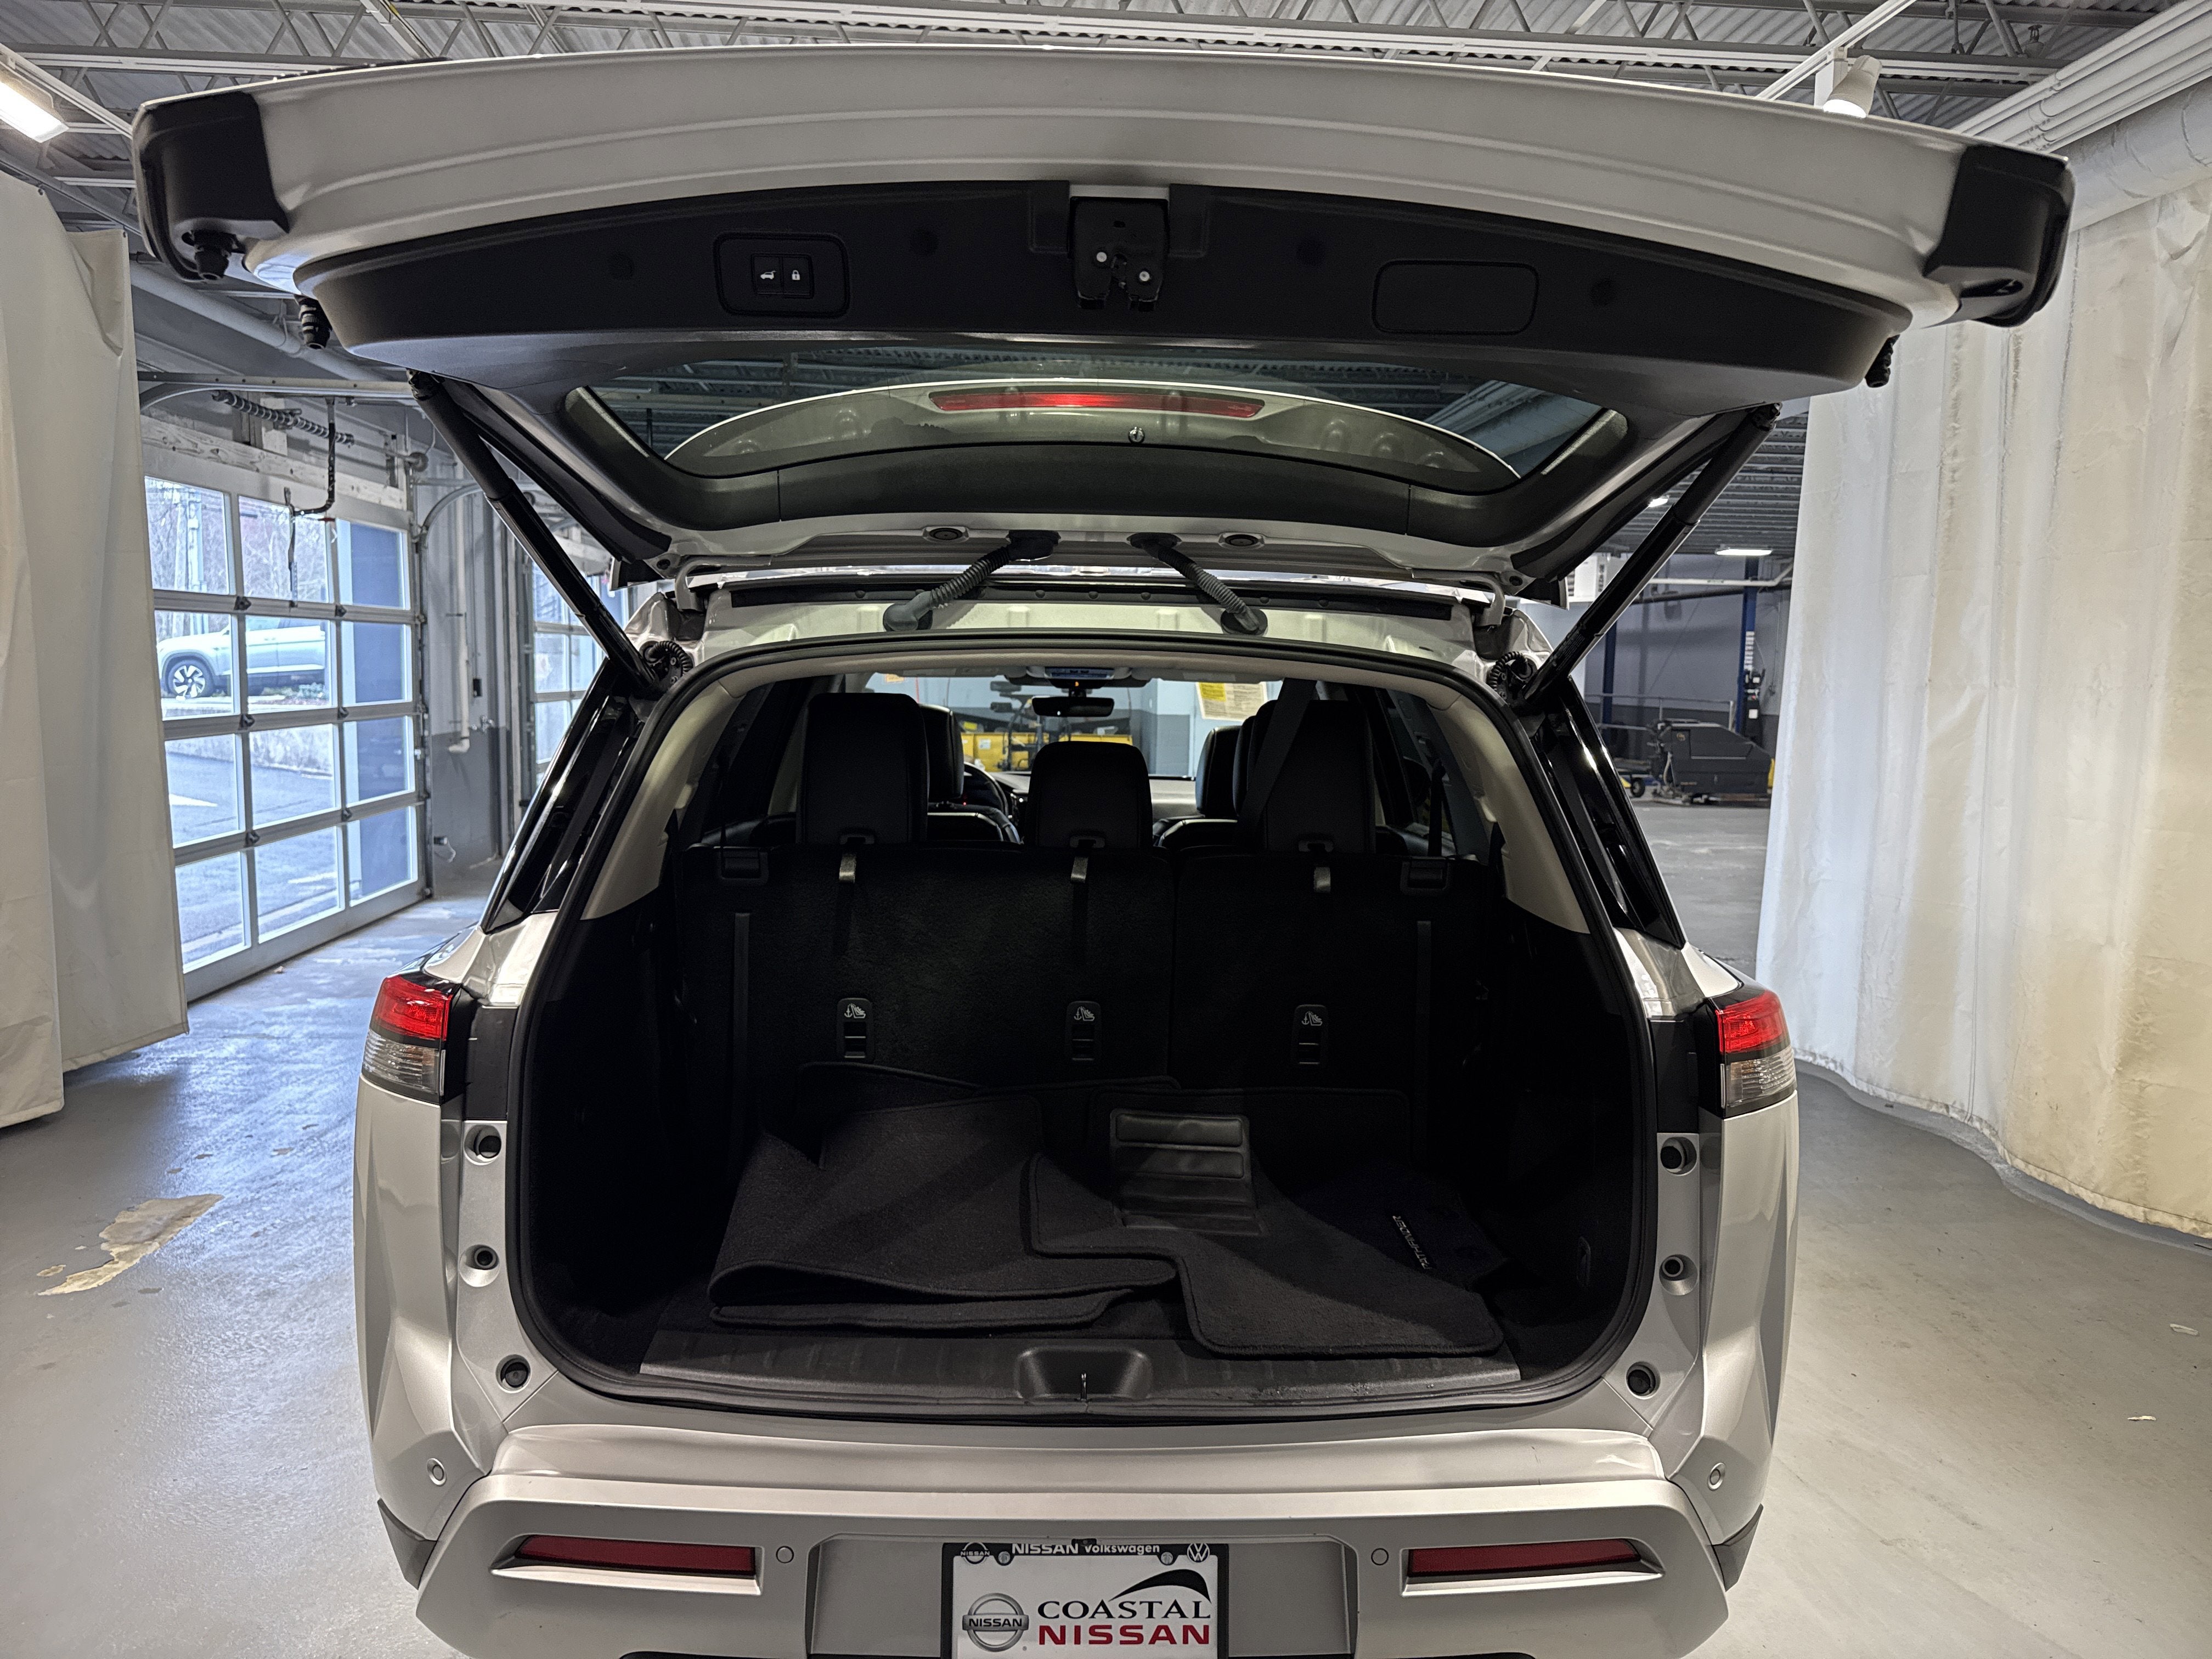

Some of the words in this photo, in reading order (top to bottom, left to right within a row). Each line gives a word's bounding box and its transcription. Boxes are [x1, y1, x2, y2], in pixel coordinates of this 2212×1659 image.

[1392, 1216, 1432, 1269] PATHFINDER
[1012, 1543, 1079, 1554] NISSAN
[1037, 1599, 1211, 1620] COASTAL
[968, 1618, 1023, 1628] NISSAN
[1039, 1624, 1210, 1645] NISSAN
